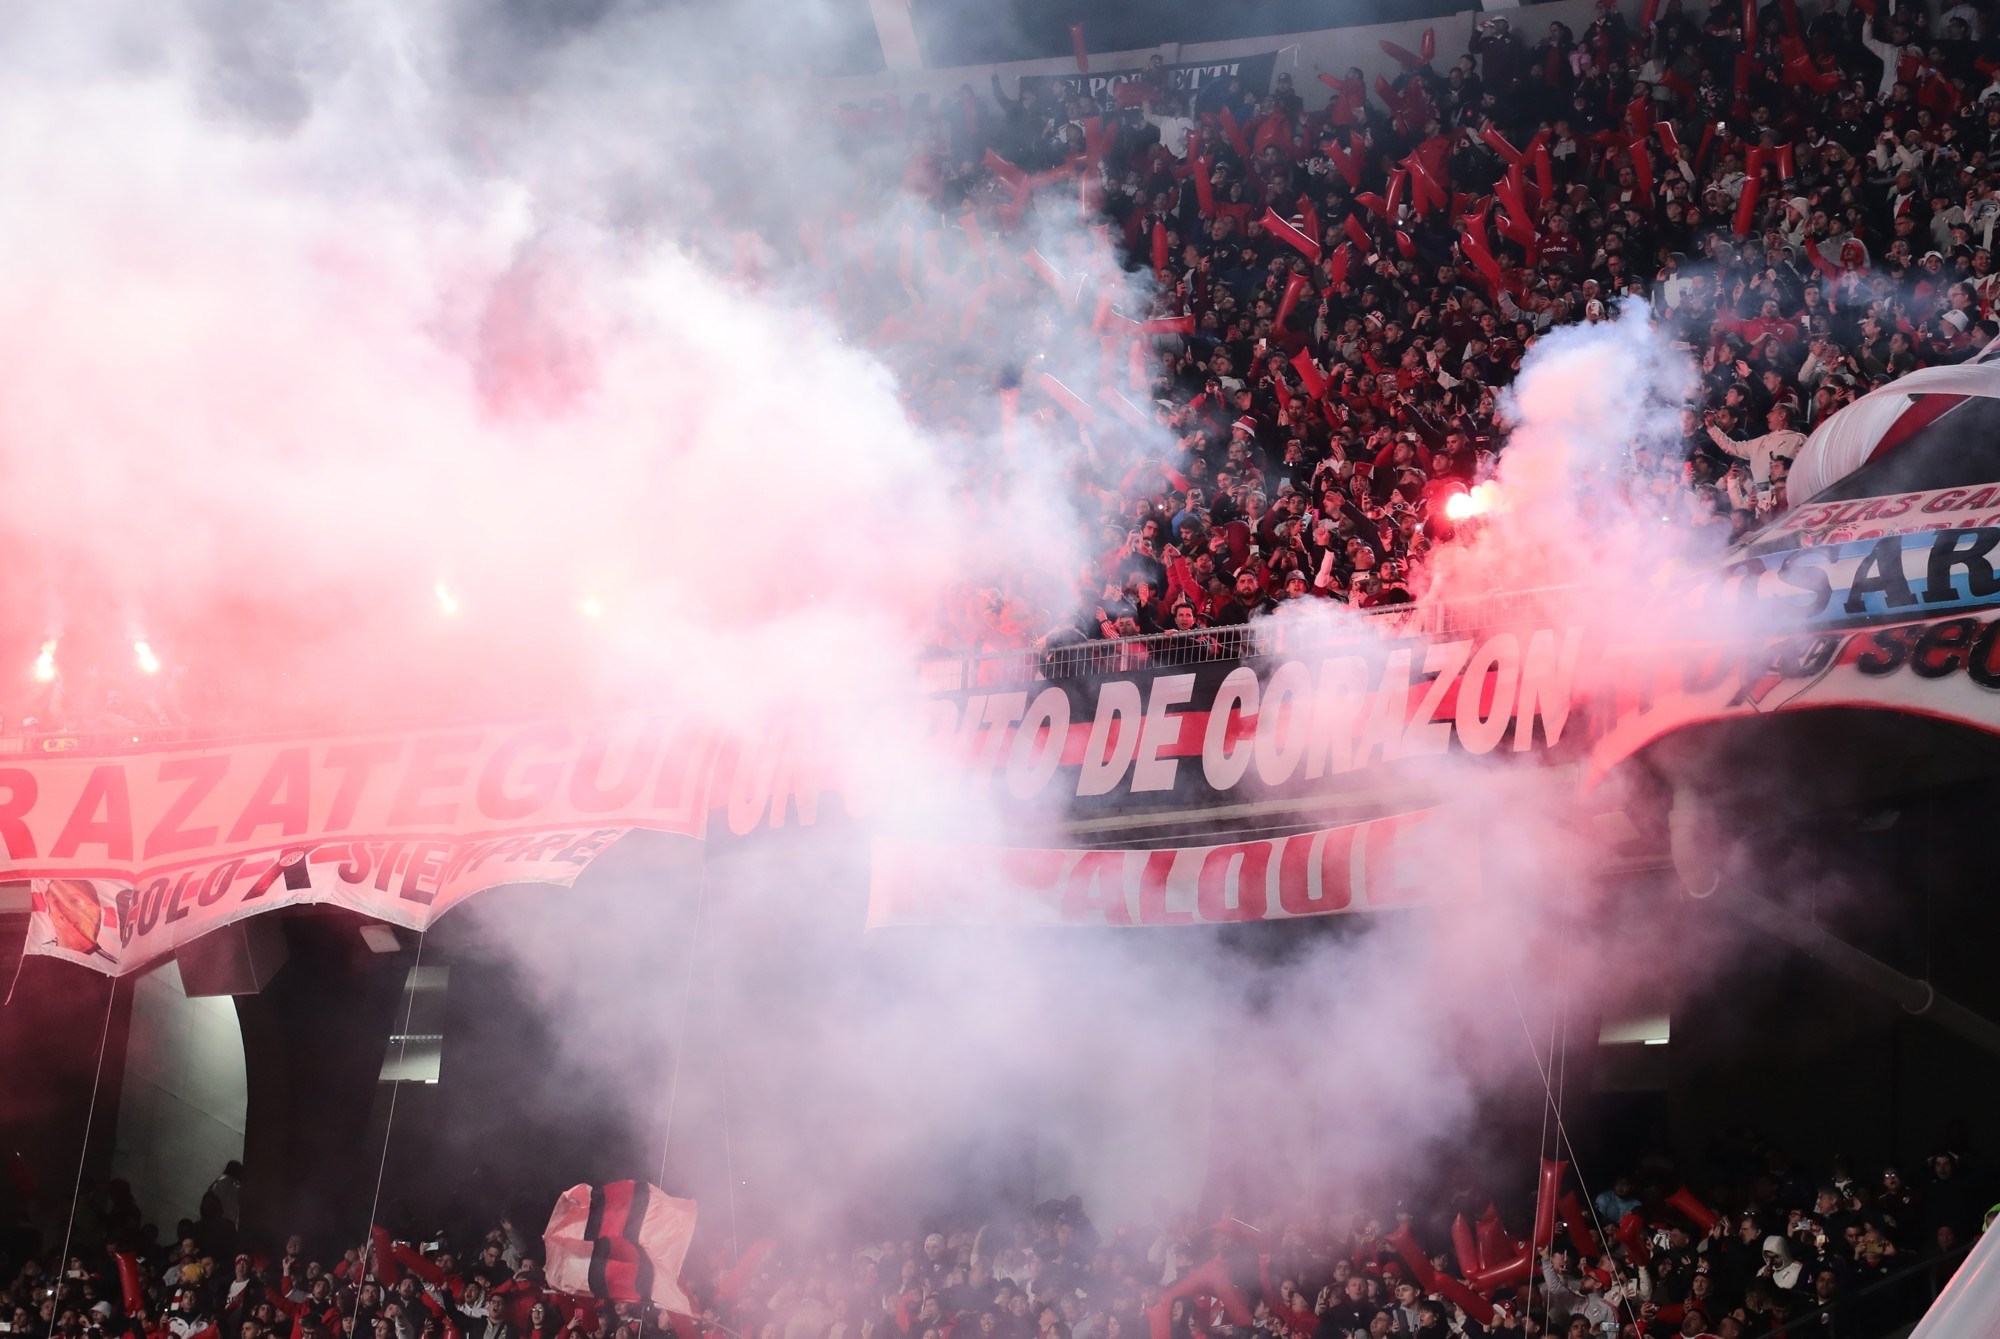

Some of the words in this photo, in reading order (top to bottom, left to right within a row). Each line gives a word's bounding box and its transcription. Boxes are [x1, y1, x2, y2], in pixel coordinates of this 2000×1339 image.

[1542, 245, 1568, 253] codere
[1077, 673, 1197, 797] DE
[1203, 625, 1585, 792] CORAZON
